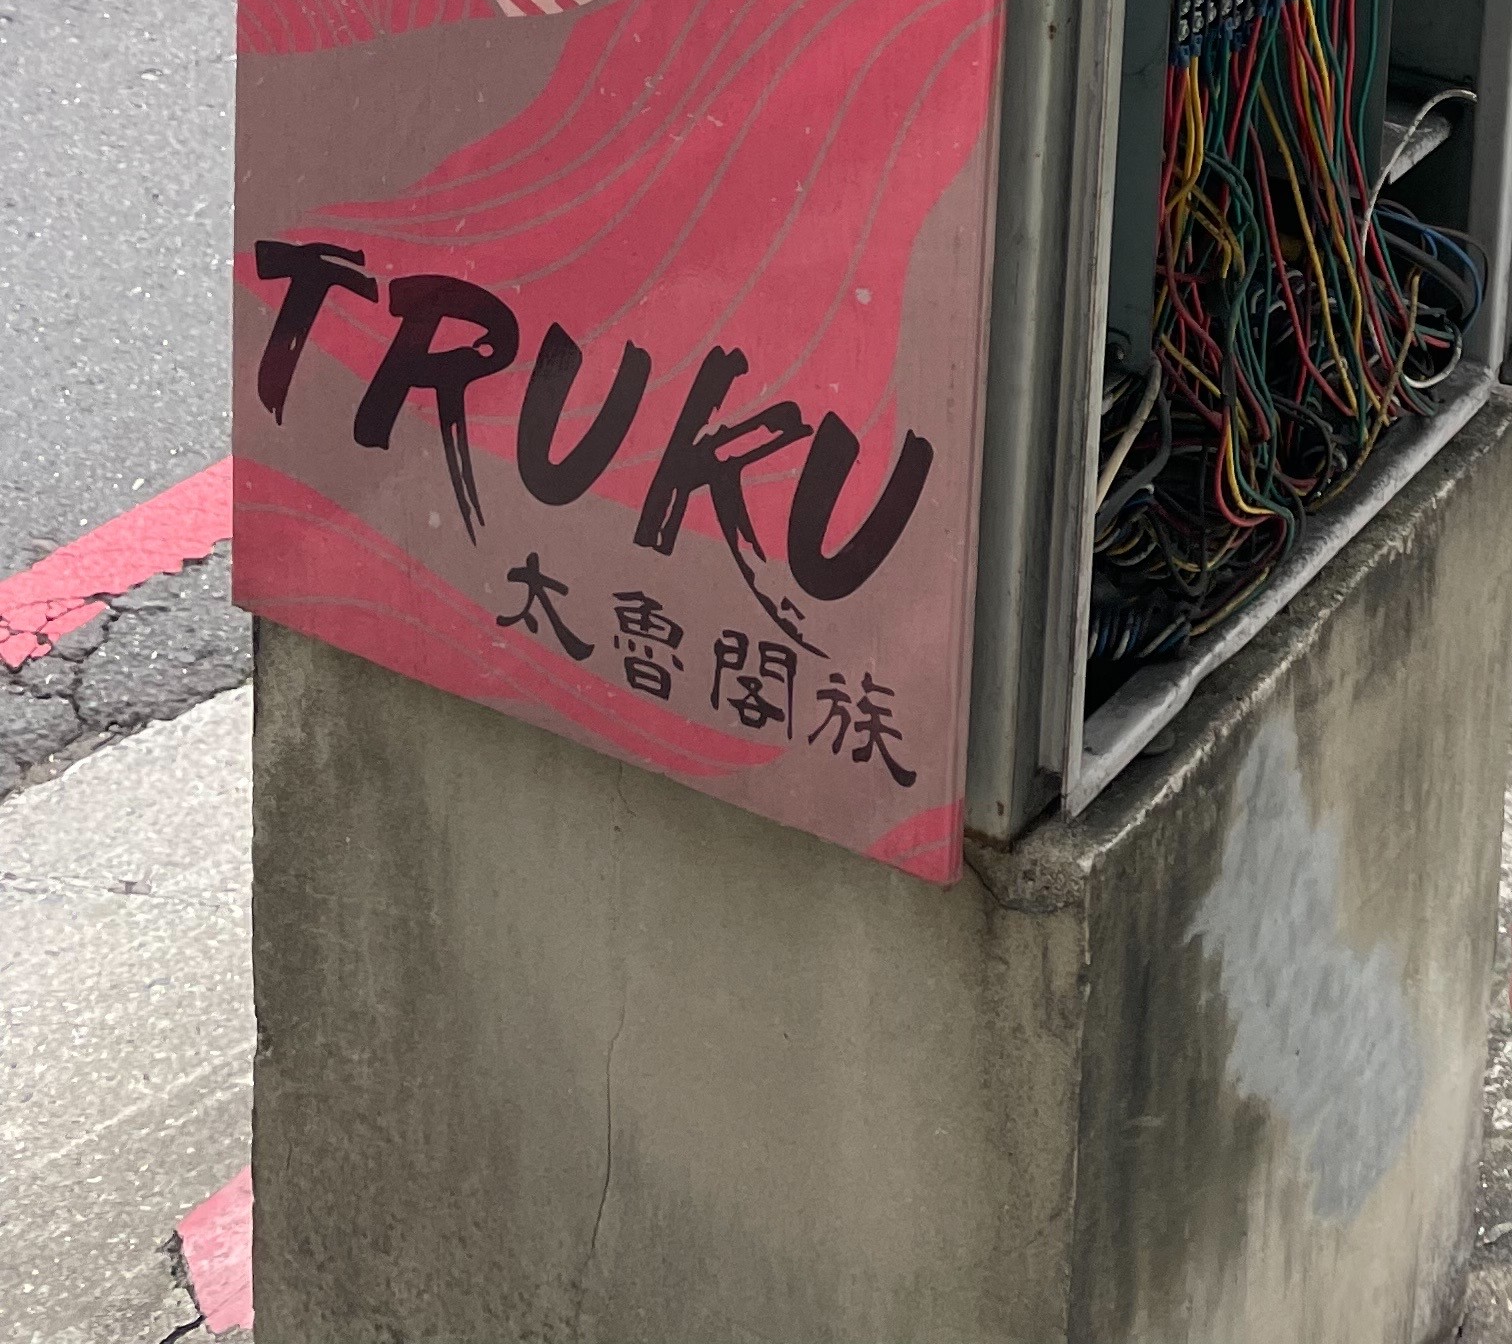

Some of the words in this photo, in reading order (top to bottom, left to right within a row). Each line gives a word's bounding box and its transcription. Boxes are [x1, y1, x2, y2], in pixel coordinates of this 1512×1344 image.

[254, 239, 935, 658] TRUKU
[496, 553, 917, 787] 太魯閣族
